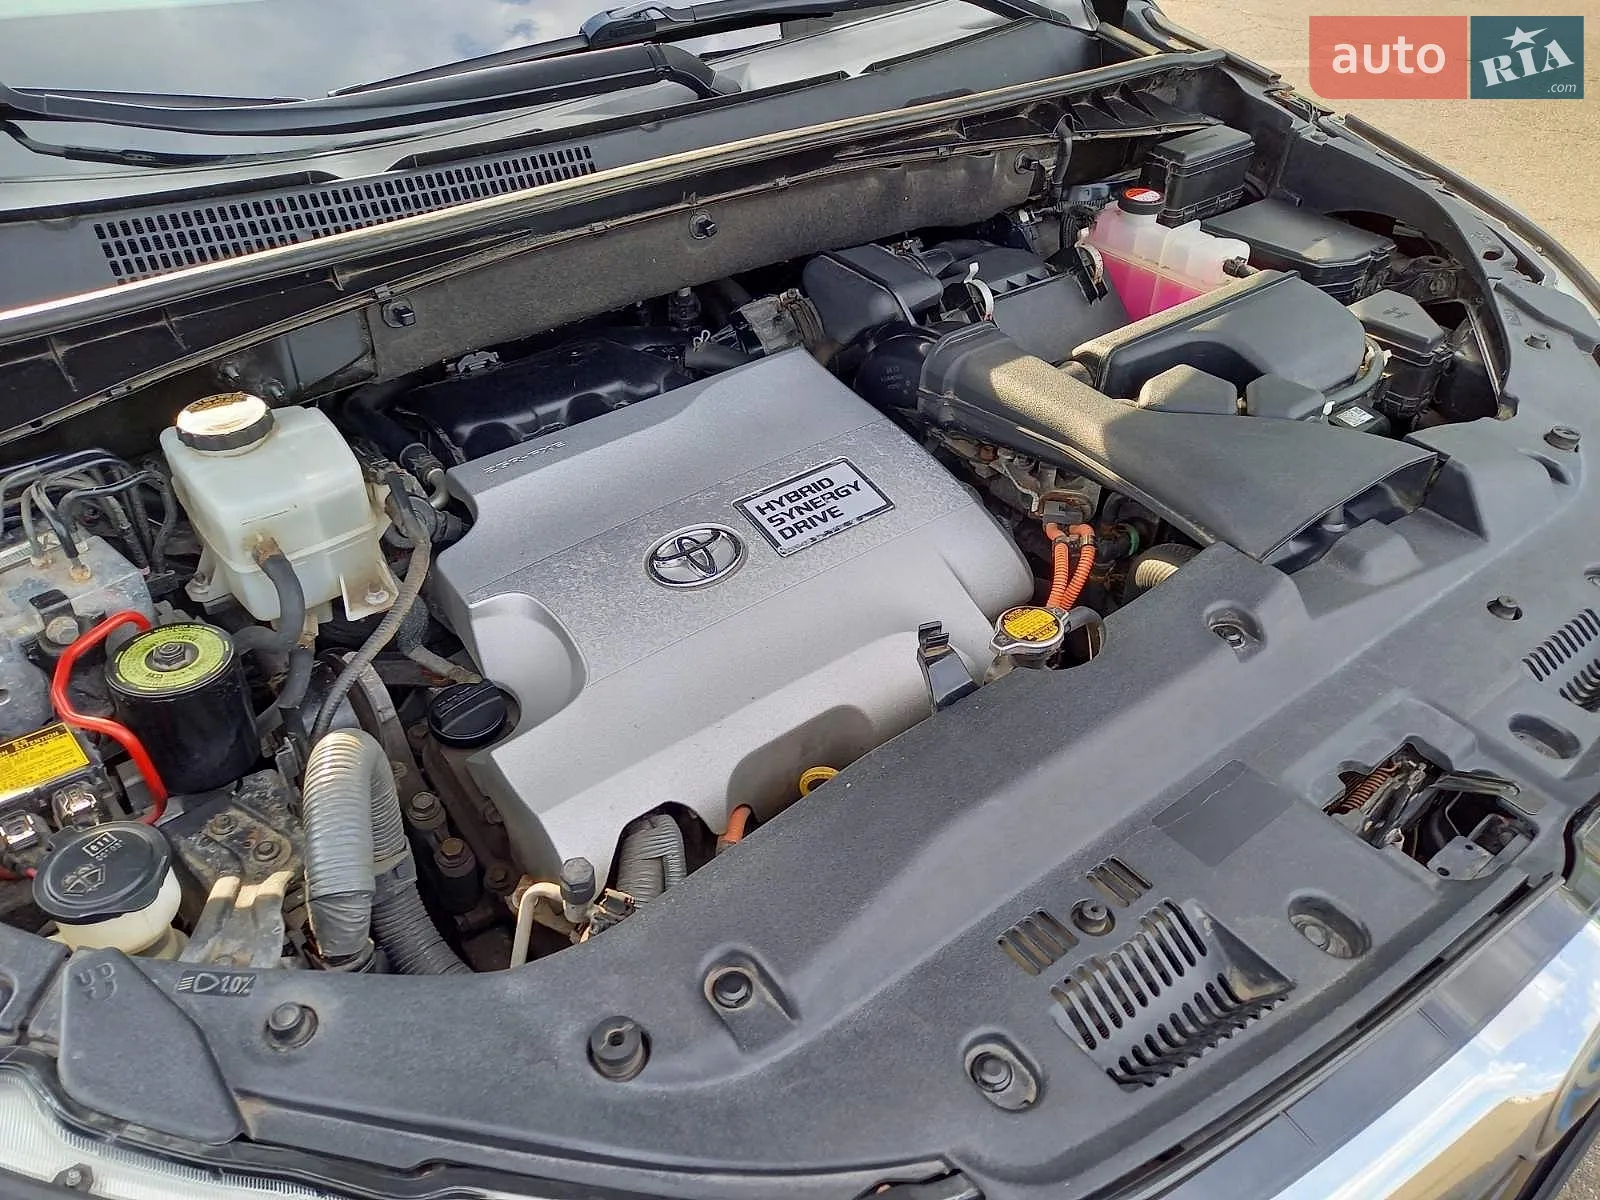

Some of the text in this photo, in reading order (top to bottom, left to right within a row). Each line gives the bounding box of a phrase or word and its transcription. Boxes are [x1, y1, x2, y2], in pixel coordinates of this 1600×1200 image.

[755, 477, 835, 516] HYBRID
[767, 480, 862, 527] SYNERGY
[778, 505, 844, 541] DRIVE
